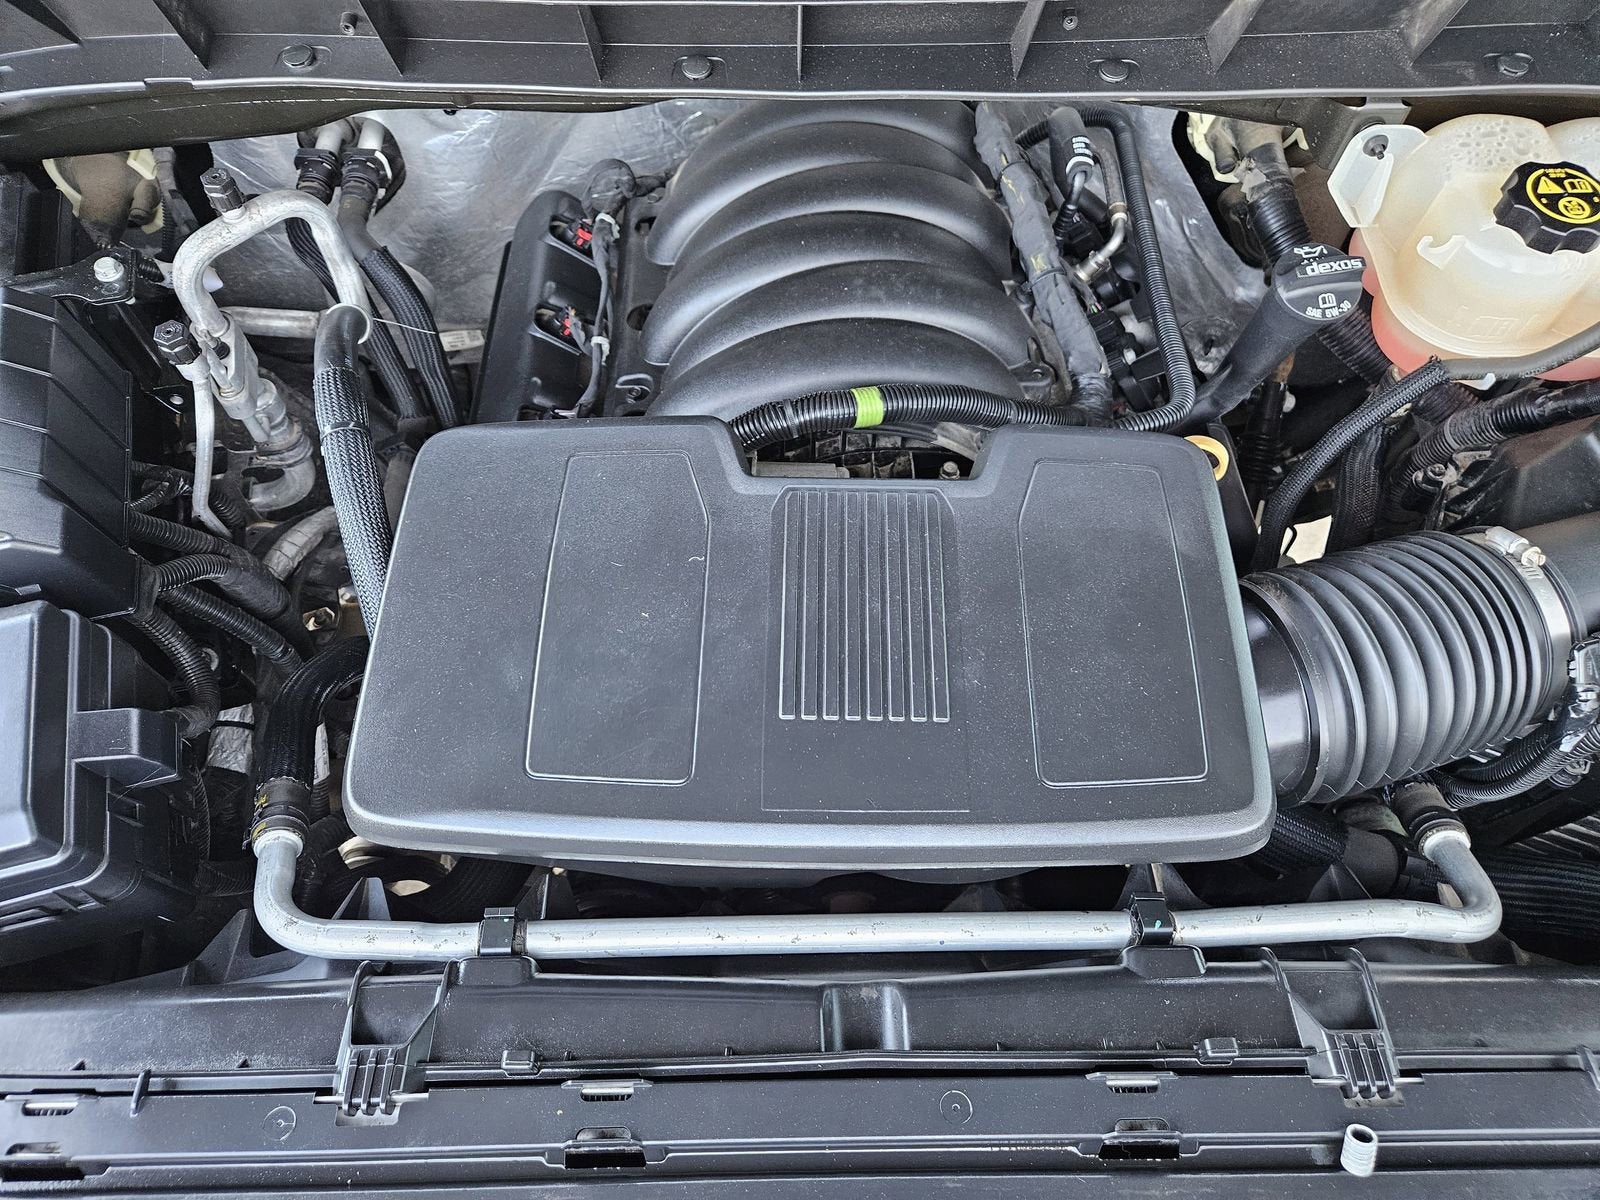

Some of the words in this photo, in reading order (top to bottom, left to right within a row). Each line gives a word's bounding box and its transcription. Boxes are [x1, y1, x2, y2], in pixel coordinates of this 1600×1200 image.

[1305, 258, 1363, 277] dexos
[1305, 306, 1323, 318] SAE
[1325, 300, 1352, 318] 5W-30
